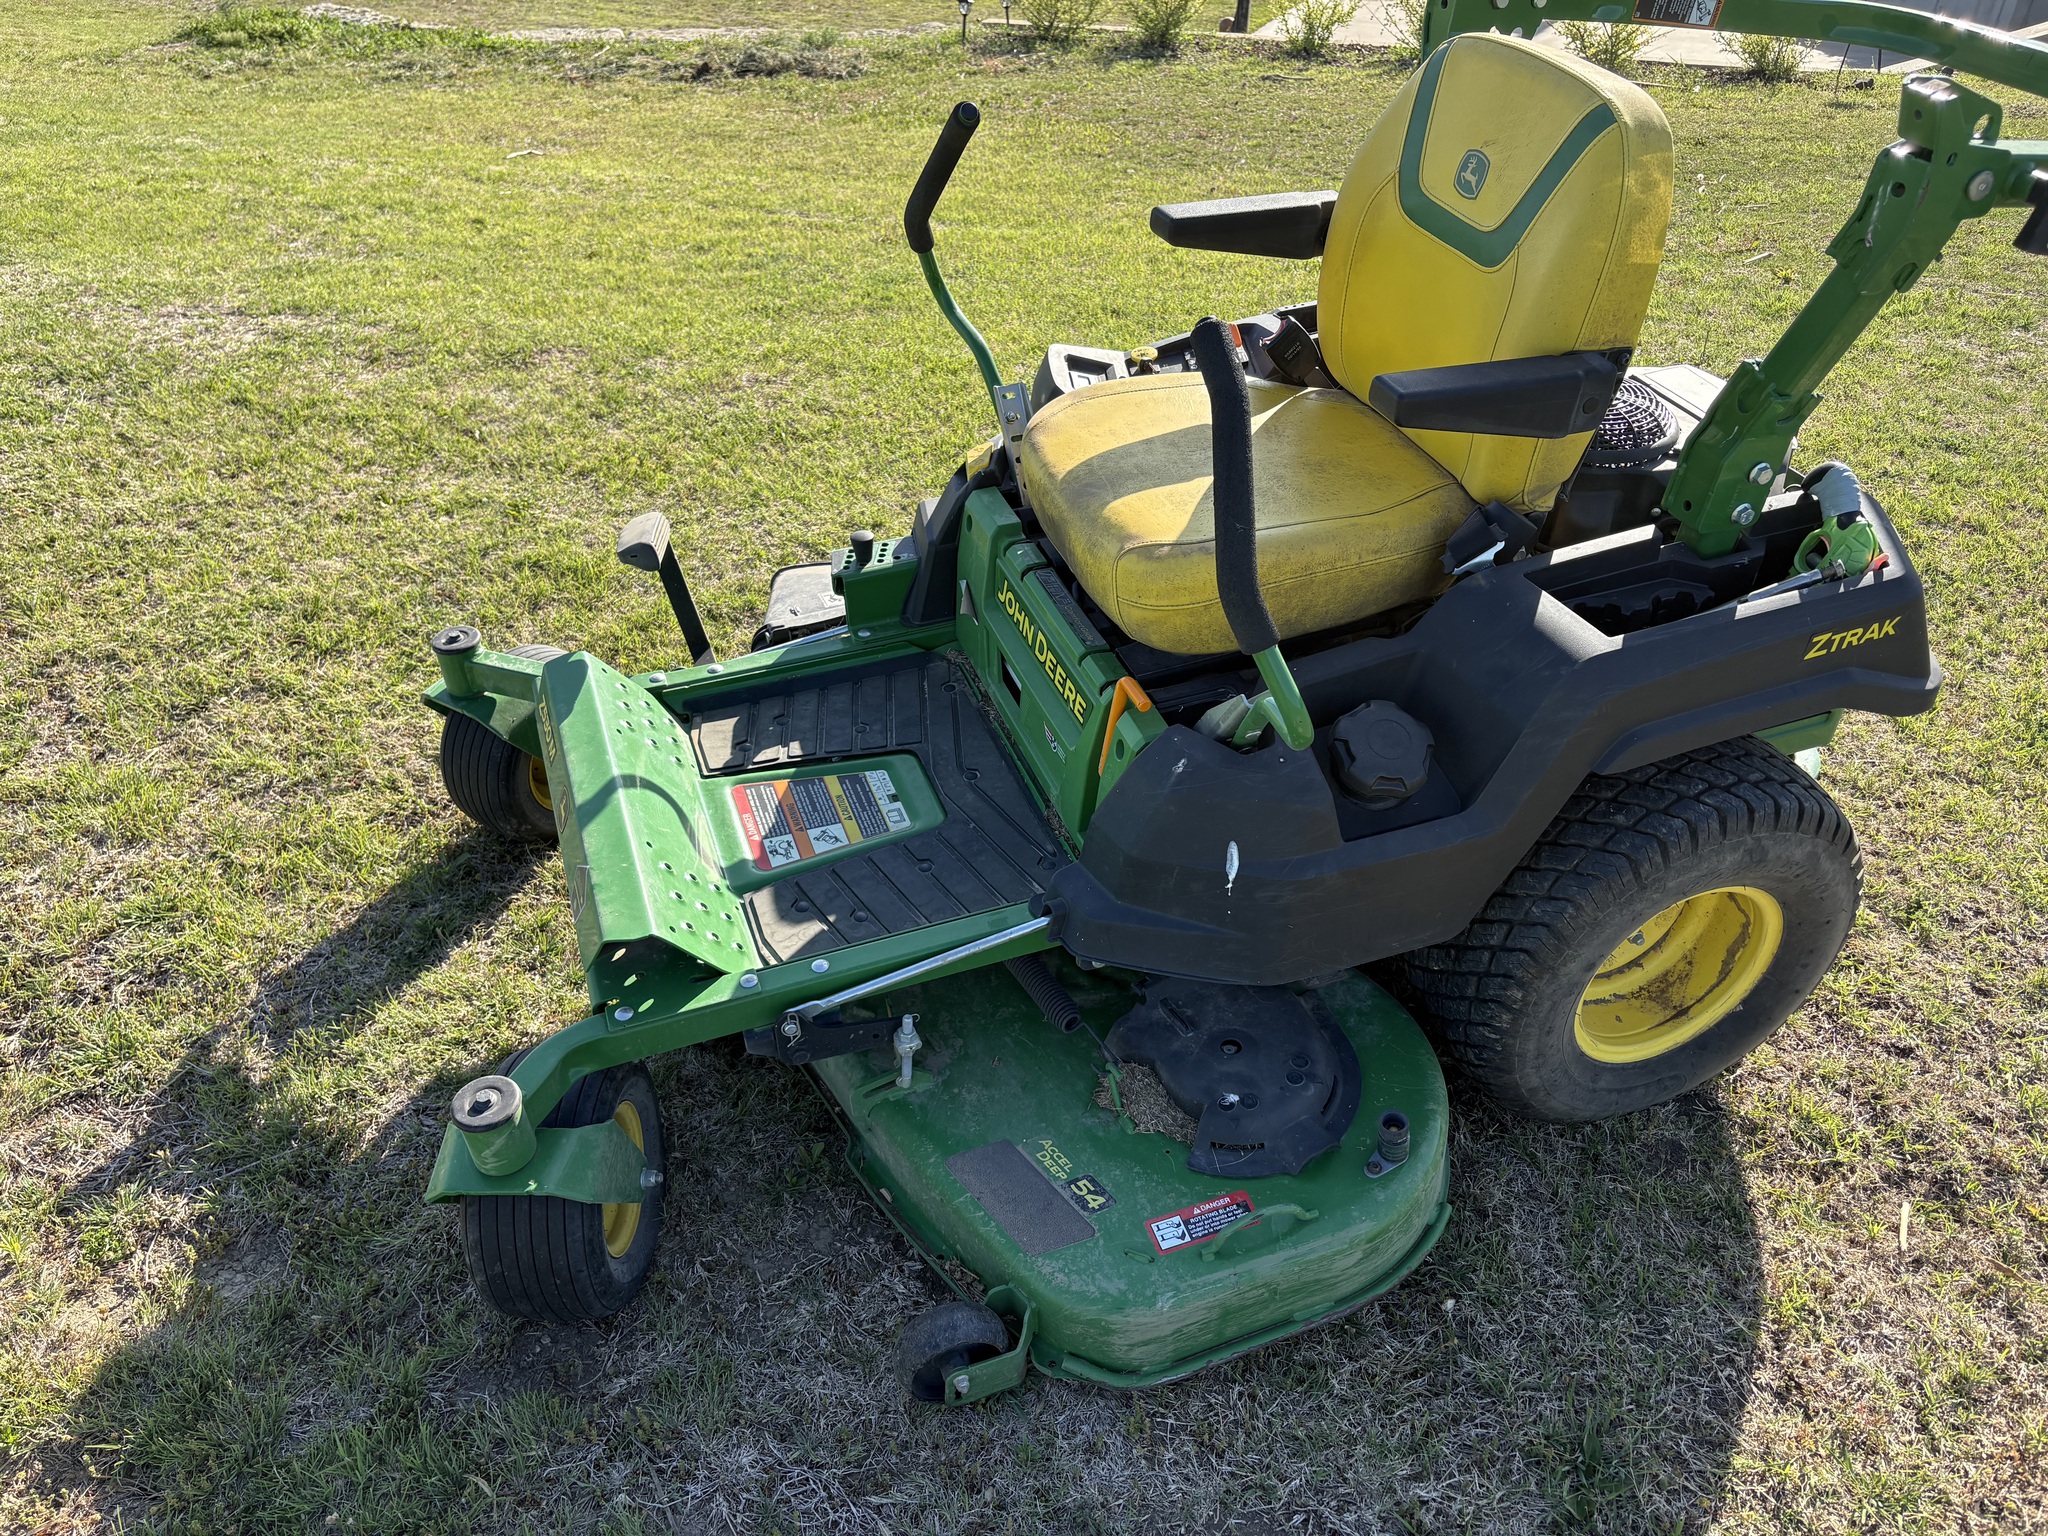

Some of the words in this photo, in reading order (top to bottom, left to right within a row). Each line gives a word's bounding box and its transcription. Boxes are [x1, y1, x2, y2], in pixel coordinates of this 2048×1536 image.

[1803, 616, 1901, 660] ZTRAK
[998, 579, 1034, 646] JOHN
[1035, 630, 1087, 724] DEERE
[786, 803, 803, 828] WARNING
[835, 794, 851, 816] CAUTION
[743, 813, 758, 836] DANGER
[1036, 1151, 1067, 1179] DEEP
[1038, 1140, 1073, 1172] ACCEL
[1070, 1179, 1106, 1209] 54
[1200, 1197, 1231, 1212] DANGER
[1189, 1210, 1218, 1224] ROTATING
[1219, 1204, 1238, 1214] BLADE
